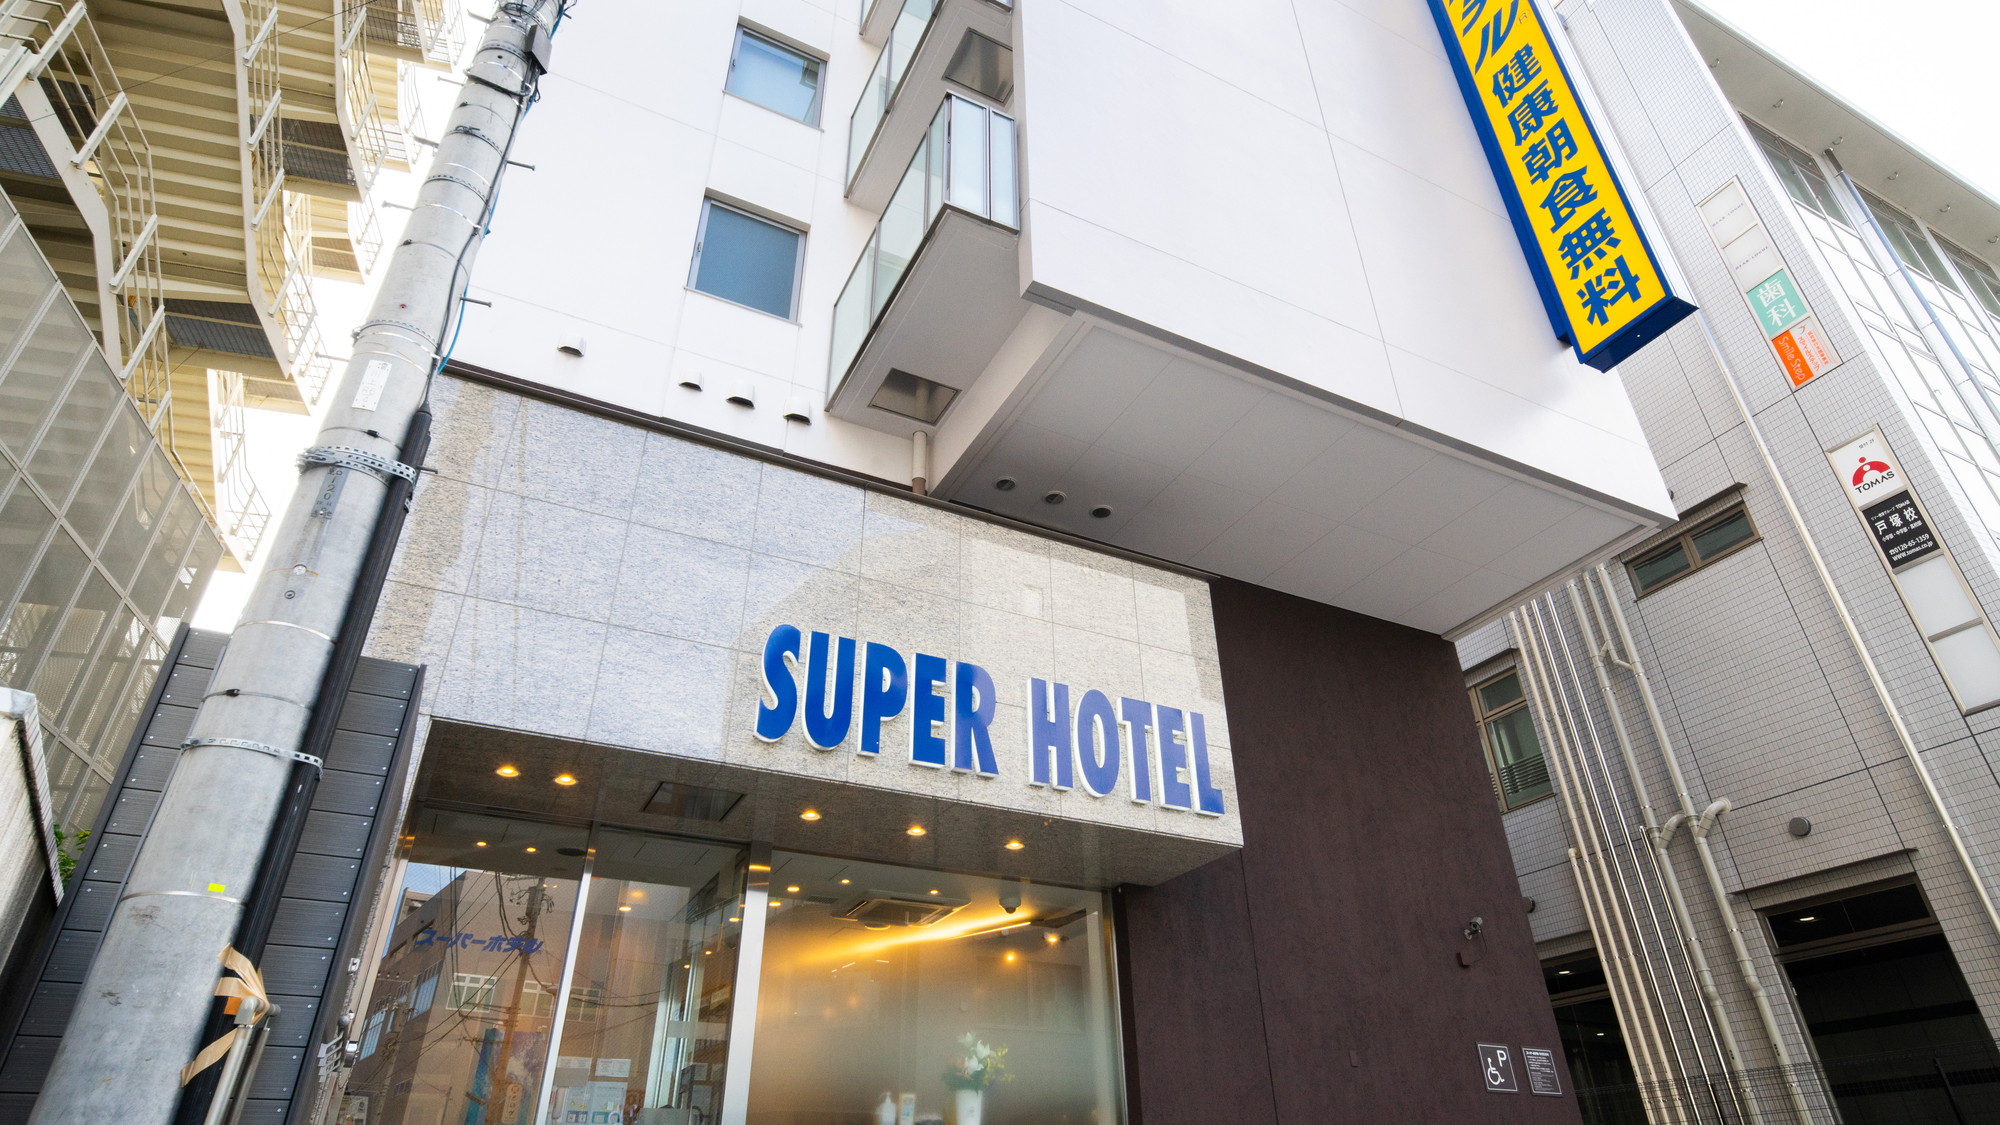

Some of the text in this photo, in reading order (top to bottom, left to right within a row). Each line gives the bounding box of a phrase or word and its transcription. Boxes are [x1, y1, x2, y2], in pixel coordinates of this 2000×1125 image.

[1491, 43, 1642, 326] 健康朝食無料
[1756, 278, 1797, 327] 歯科
[1778, 336, 1806, 381] Smile Step
[1855, 471, 1895, 494] TOMAS
[1874, 507, 1919, 536] 戸塚校
[1891, 540, 1934, 562] www.tomas.co.jp
[753, 624, 1225, 817] SUPER HOTEL
[415, 929, 544, 955] スーパーホテル
[1497, 1050, 1507, 1067] P
